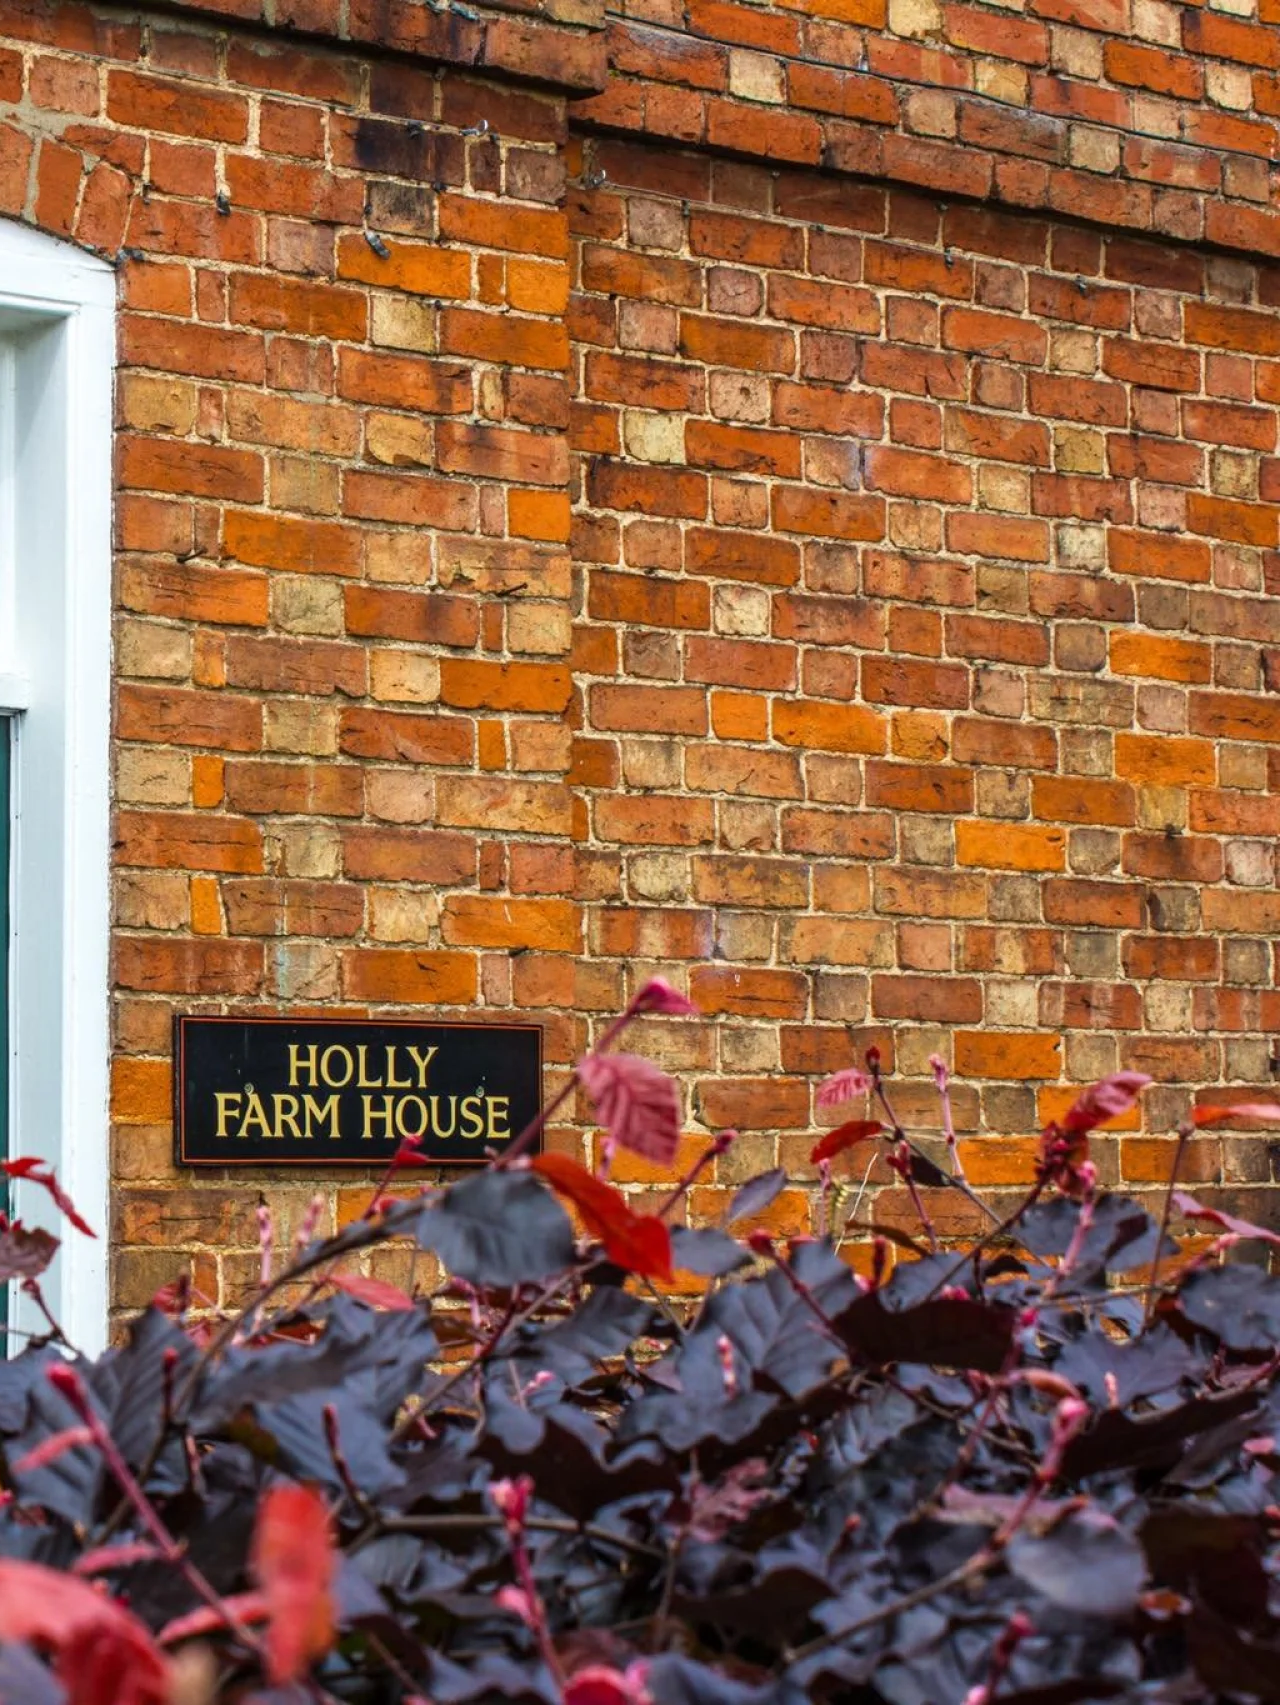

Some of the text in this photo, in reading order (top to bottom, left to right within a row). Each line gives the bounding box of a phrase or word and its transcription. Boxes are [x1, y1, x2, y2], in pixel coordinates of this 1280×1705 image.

[288, 1044, 439, 1088] HOLLY
[214, 1092, 511, 1139] FARM HOUSE
